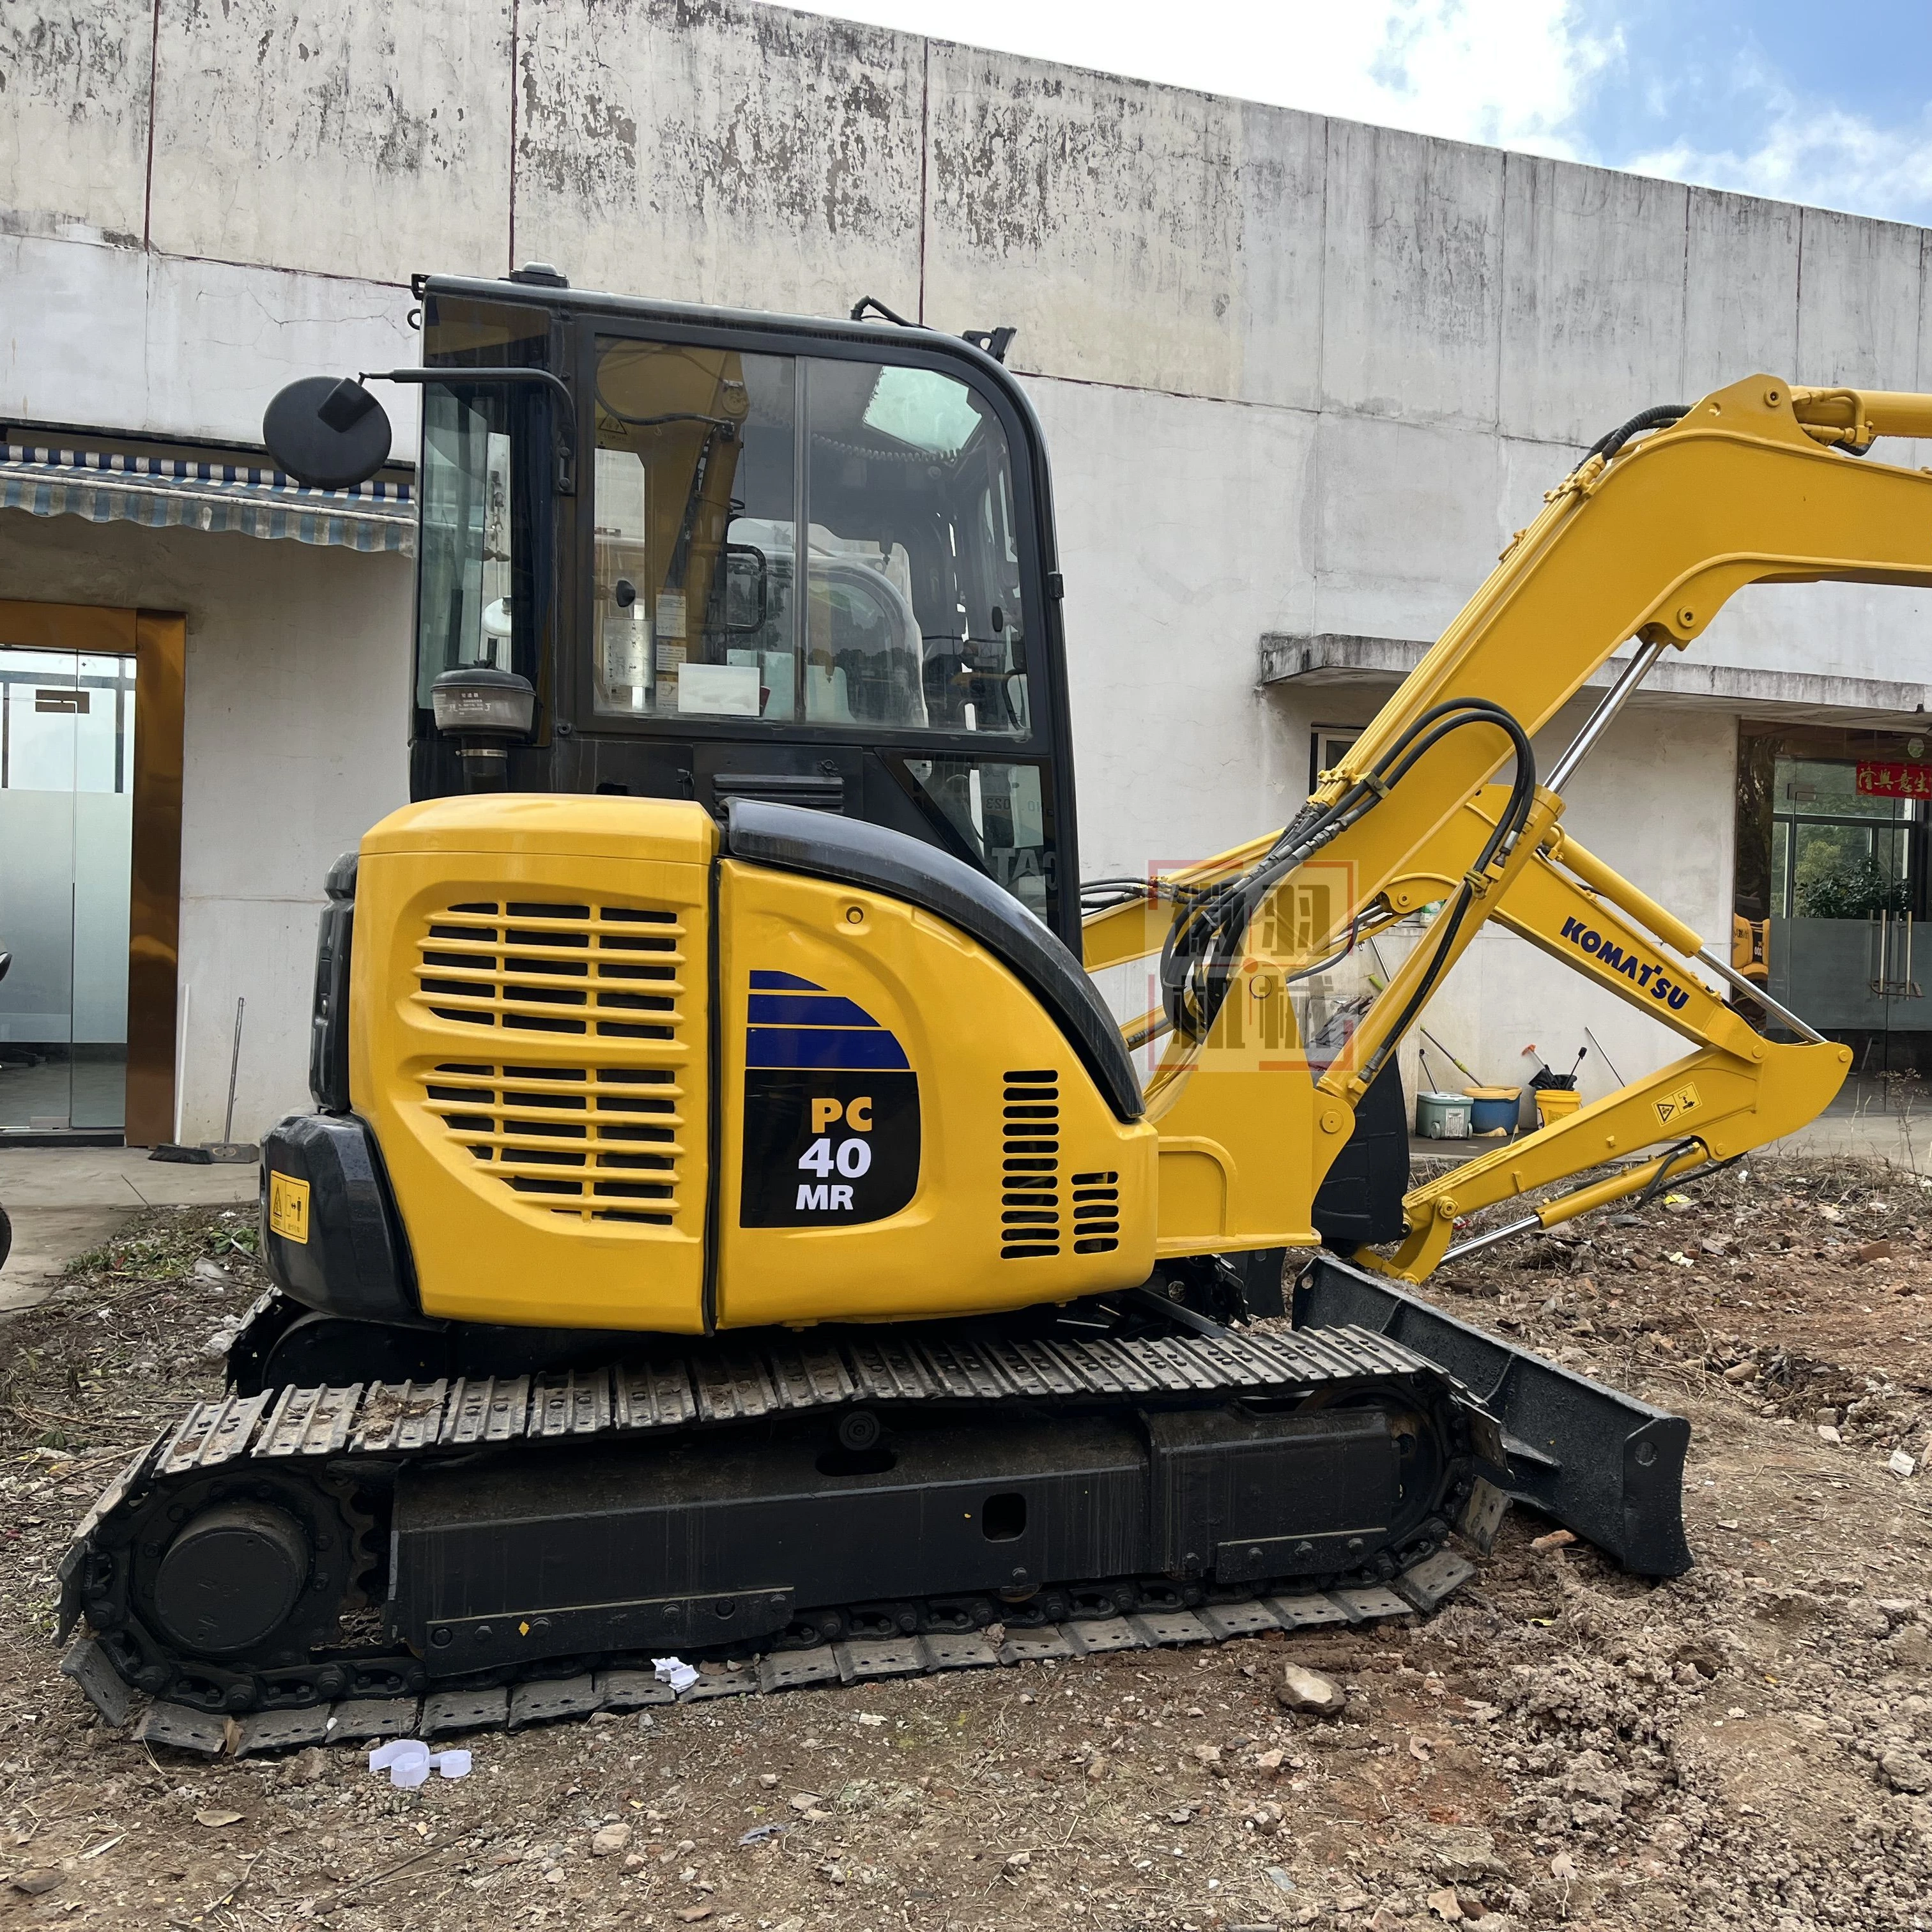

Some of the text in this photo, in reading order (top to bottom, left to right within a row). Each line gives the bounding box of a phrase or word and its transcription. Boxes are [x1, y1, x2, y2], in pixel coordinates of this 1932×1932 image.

[1560, 916, 1690, 1009] KOMATSU
[811, 1096, 872, 1133] PC
[798, 1138, 871, 1178] 40
[795, 1184, 854, 1209] MR
